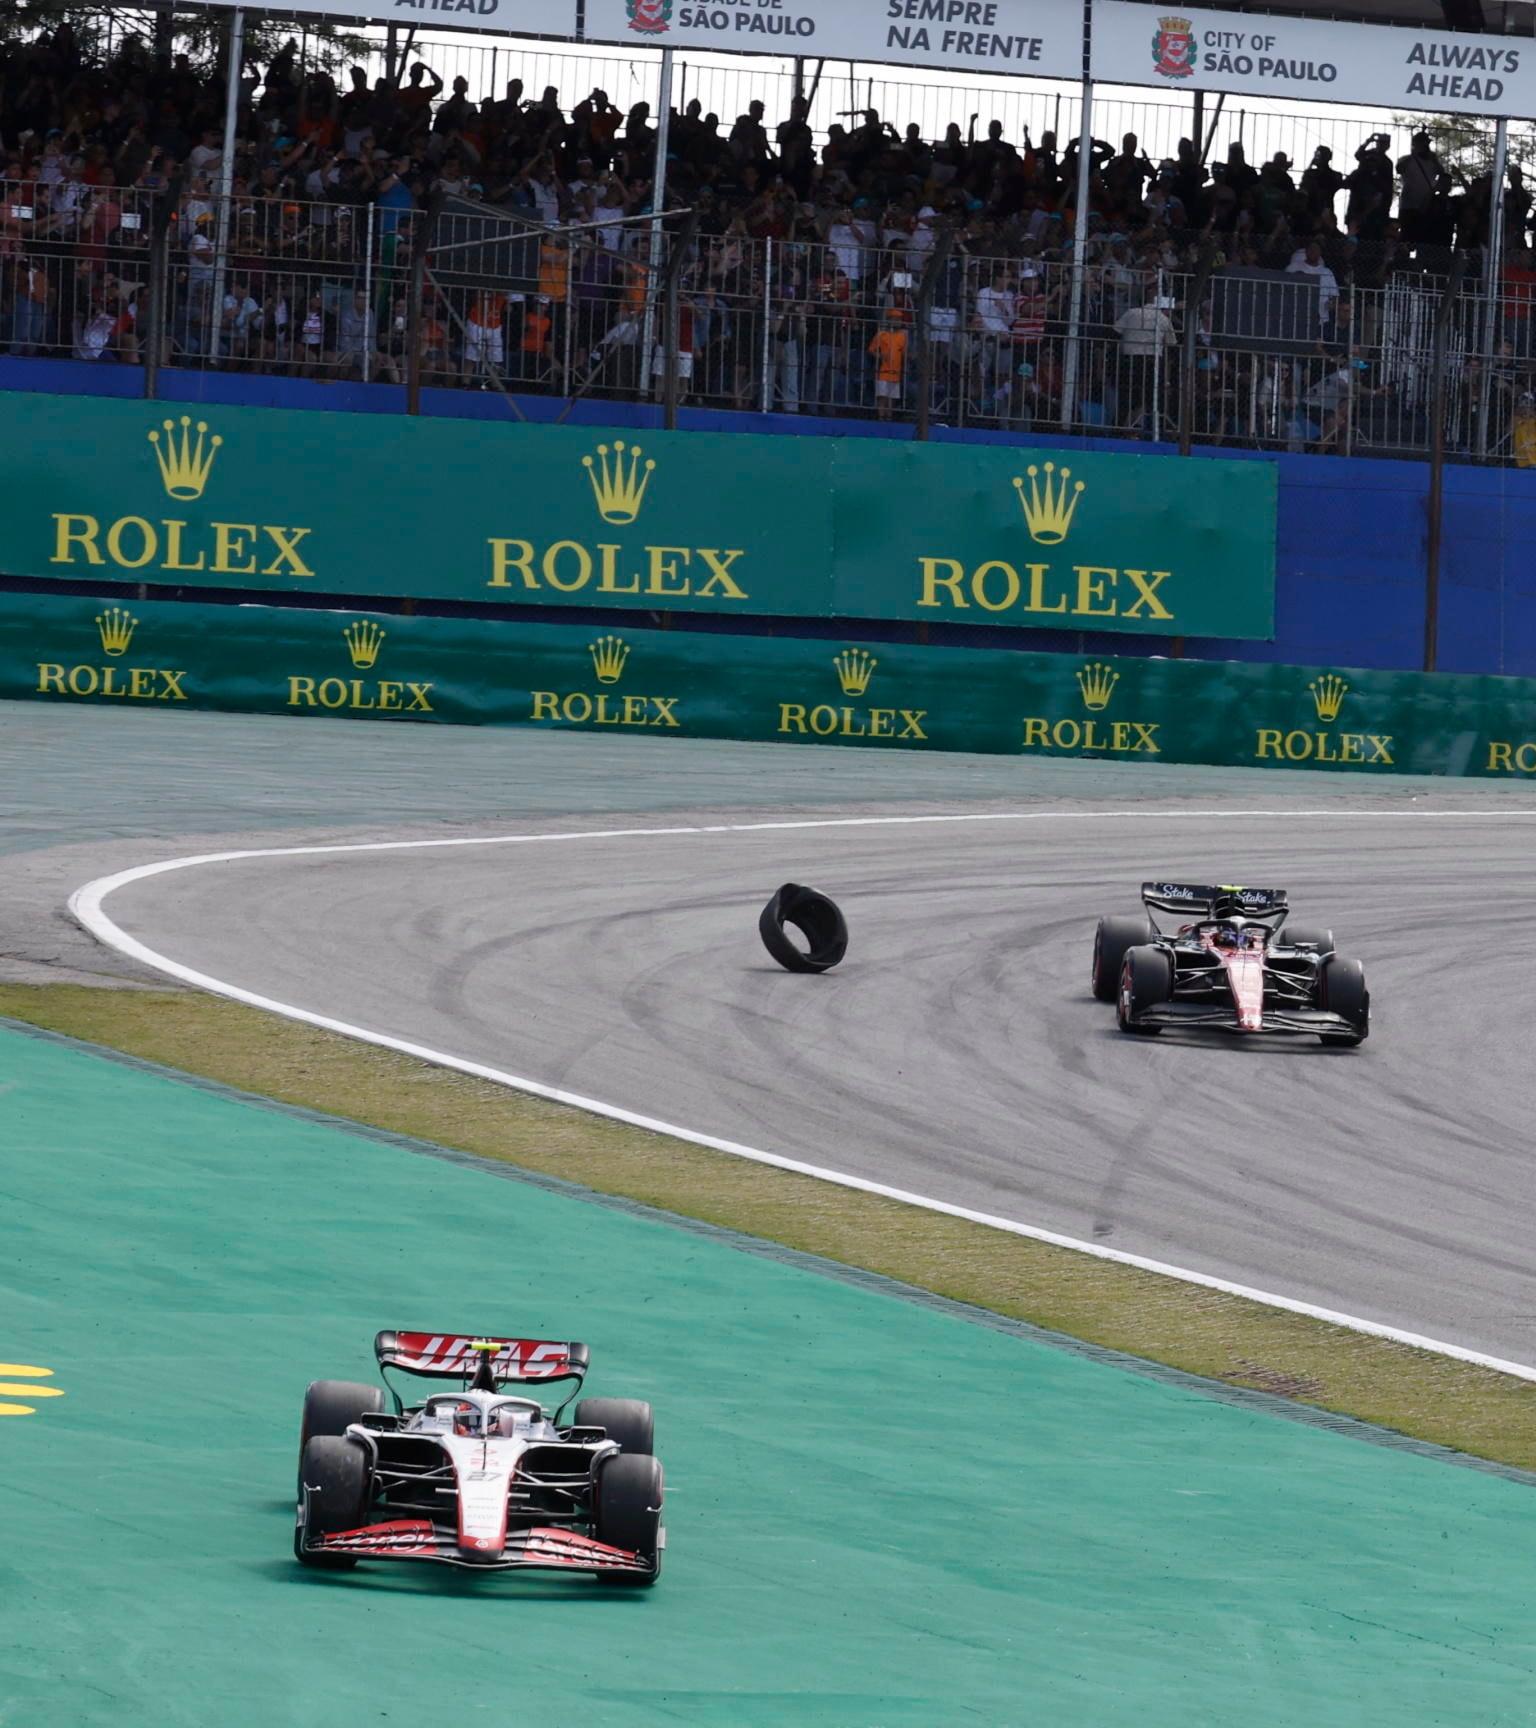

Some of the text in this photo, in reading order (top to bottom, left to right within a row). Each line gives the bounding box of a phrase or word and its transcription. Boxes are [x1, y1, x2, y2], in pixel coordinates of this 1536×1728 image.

[395, 0, 499, 15] EAD
[679, 5, 816, 37] SÃO PAULO
[887, 0, 998, 26] SEMPRE
[886, 25, 1043, 61] NA FRENTE
[1203, 30, 1276, 52] CITY OF
[1405, 42, 1520, 74] ALWAYS
[1203, 50, 1337, 83] SÃO PAULO
[1405, 72, 1504, 102] AHEAD
[51, 513, 315, 577] ROLEX
[486, 538, 748, 599] ROLEX
[917, 557, 1174, 620] ROLEX
[36, 663, 188, 700] ROLEX
[287, 676, 434, 712] ROLEX
[531, 691, 680, 727] ROLEX
[778, 703, 928, 740] ROLEX
[1023, 718, 1161, 753] ROLEX
[1255, 729, 1395, 764] ROLEX
[1163, 885, 1194, 899] Stake
